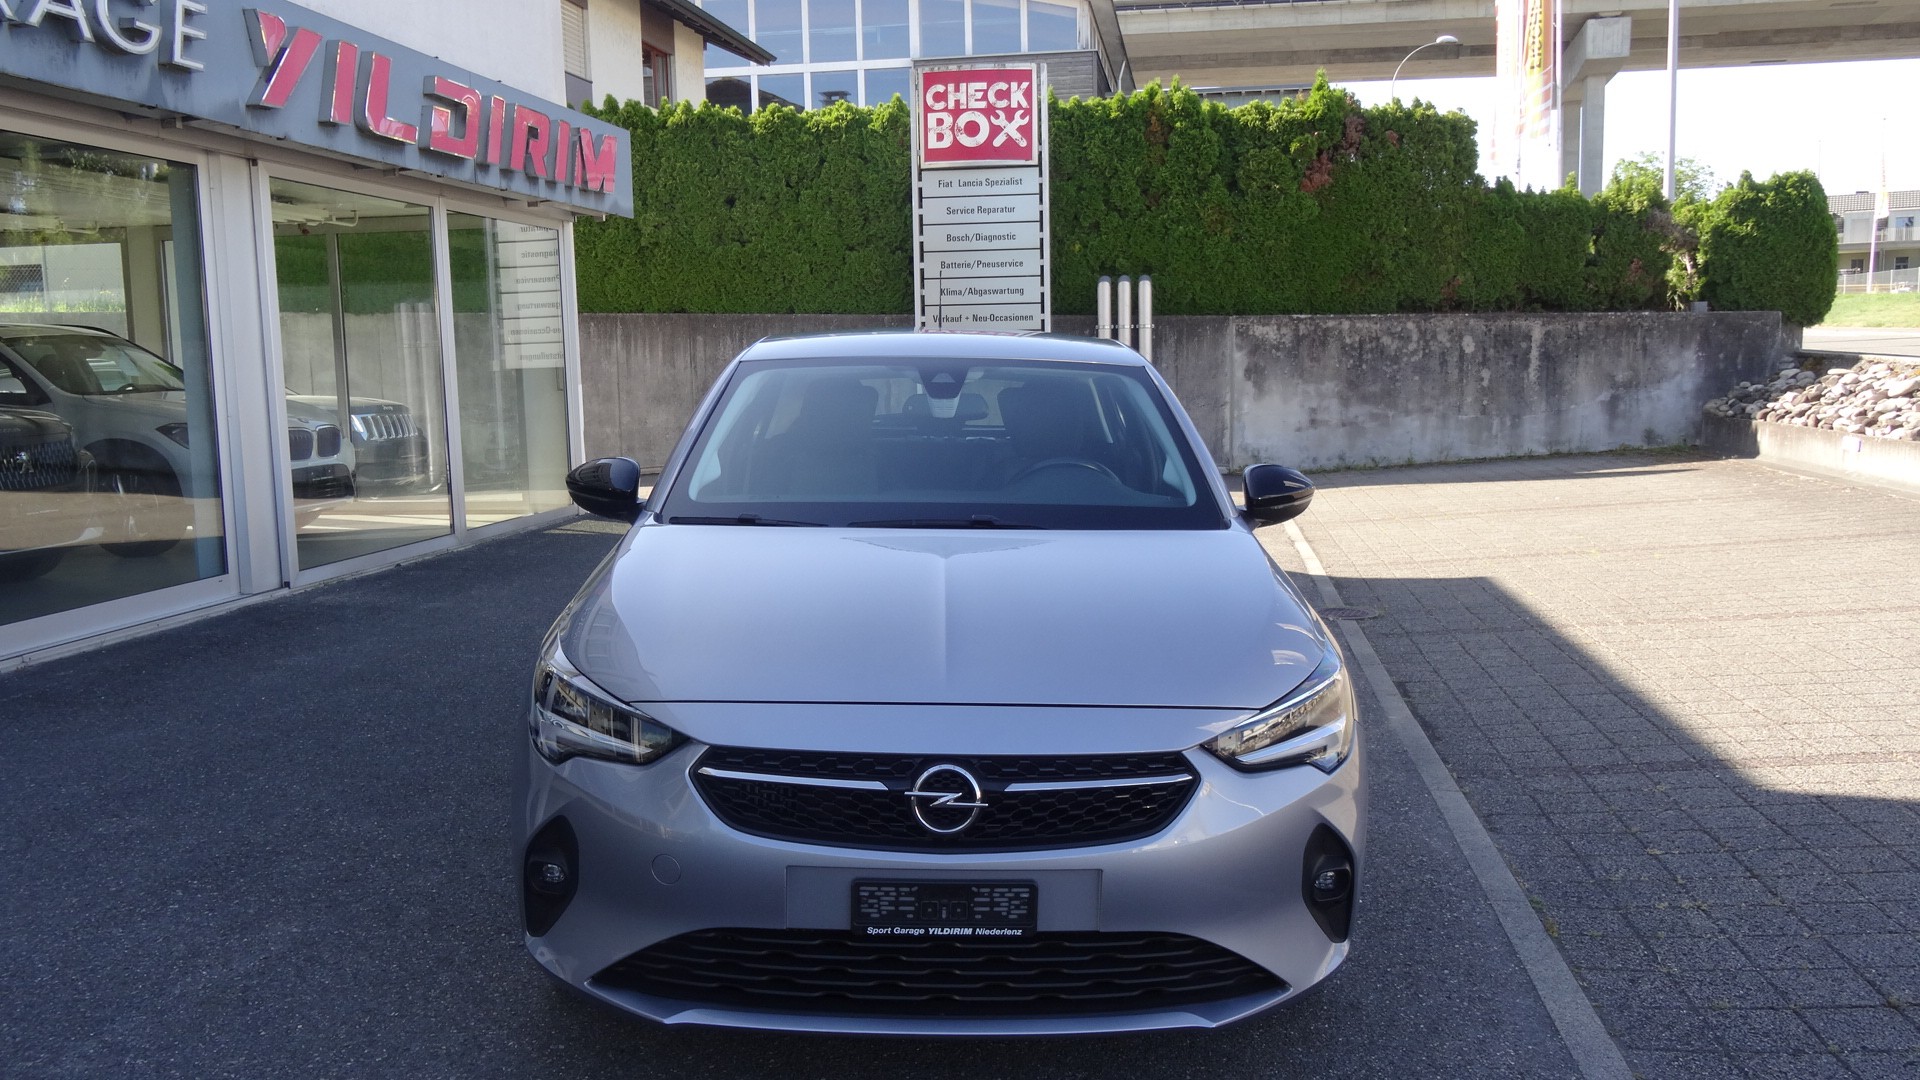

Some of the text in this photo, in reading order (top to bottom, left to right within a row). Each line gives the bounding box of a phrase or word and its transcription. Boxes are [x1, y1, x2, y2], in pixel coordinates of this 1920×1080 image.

[243, 8, 618, 194] YILDIRIM
[925, 81, 1030, 111] CHECK
[938, 178, 1023, 188] Fiat Lancia Spezialist
[946, 205, 1015, 216] Service Reparatur
[946, 232, 1016, 244] Bosch/Diagnostic
[940, 259, 1024, 270] Batterie/Pneuservice
[940, 287, 1024, 297] Klima/Abgaswartung
[972, 313, 1033, 323] Neu-Occasionen
[867, 927, 1022, 936] Sport Garage YILDIRIM Niederlenz
